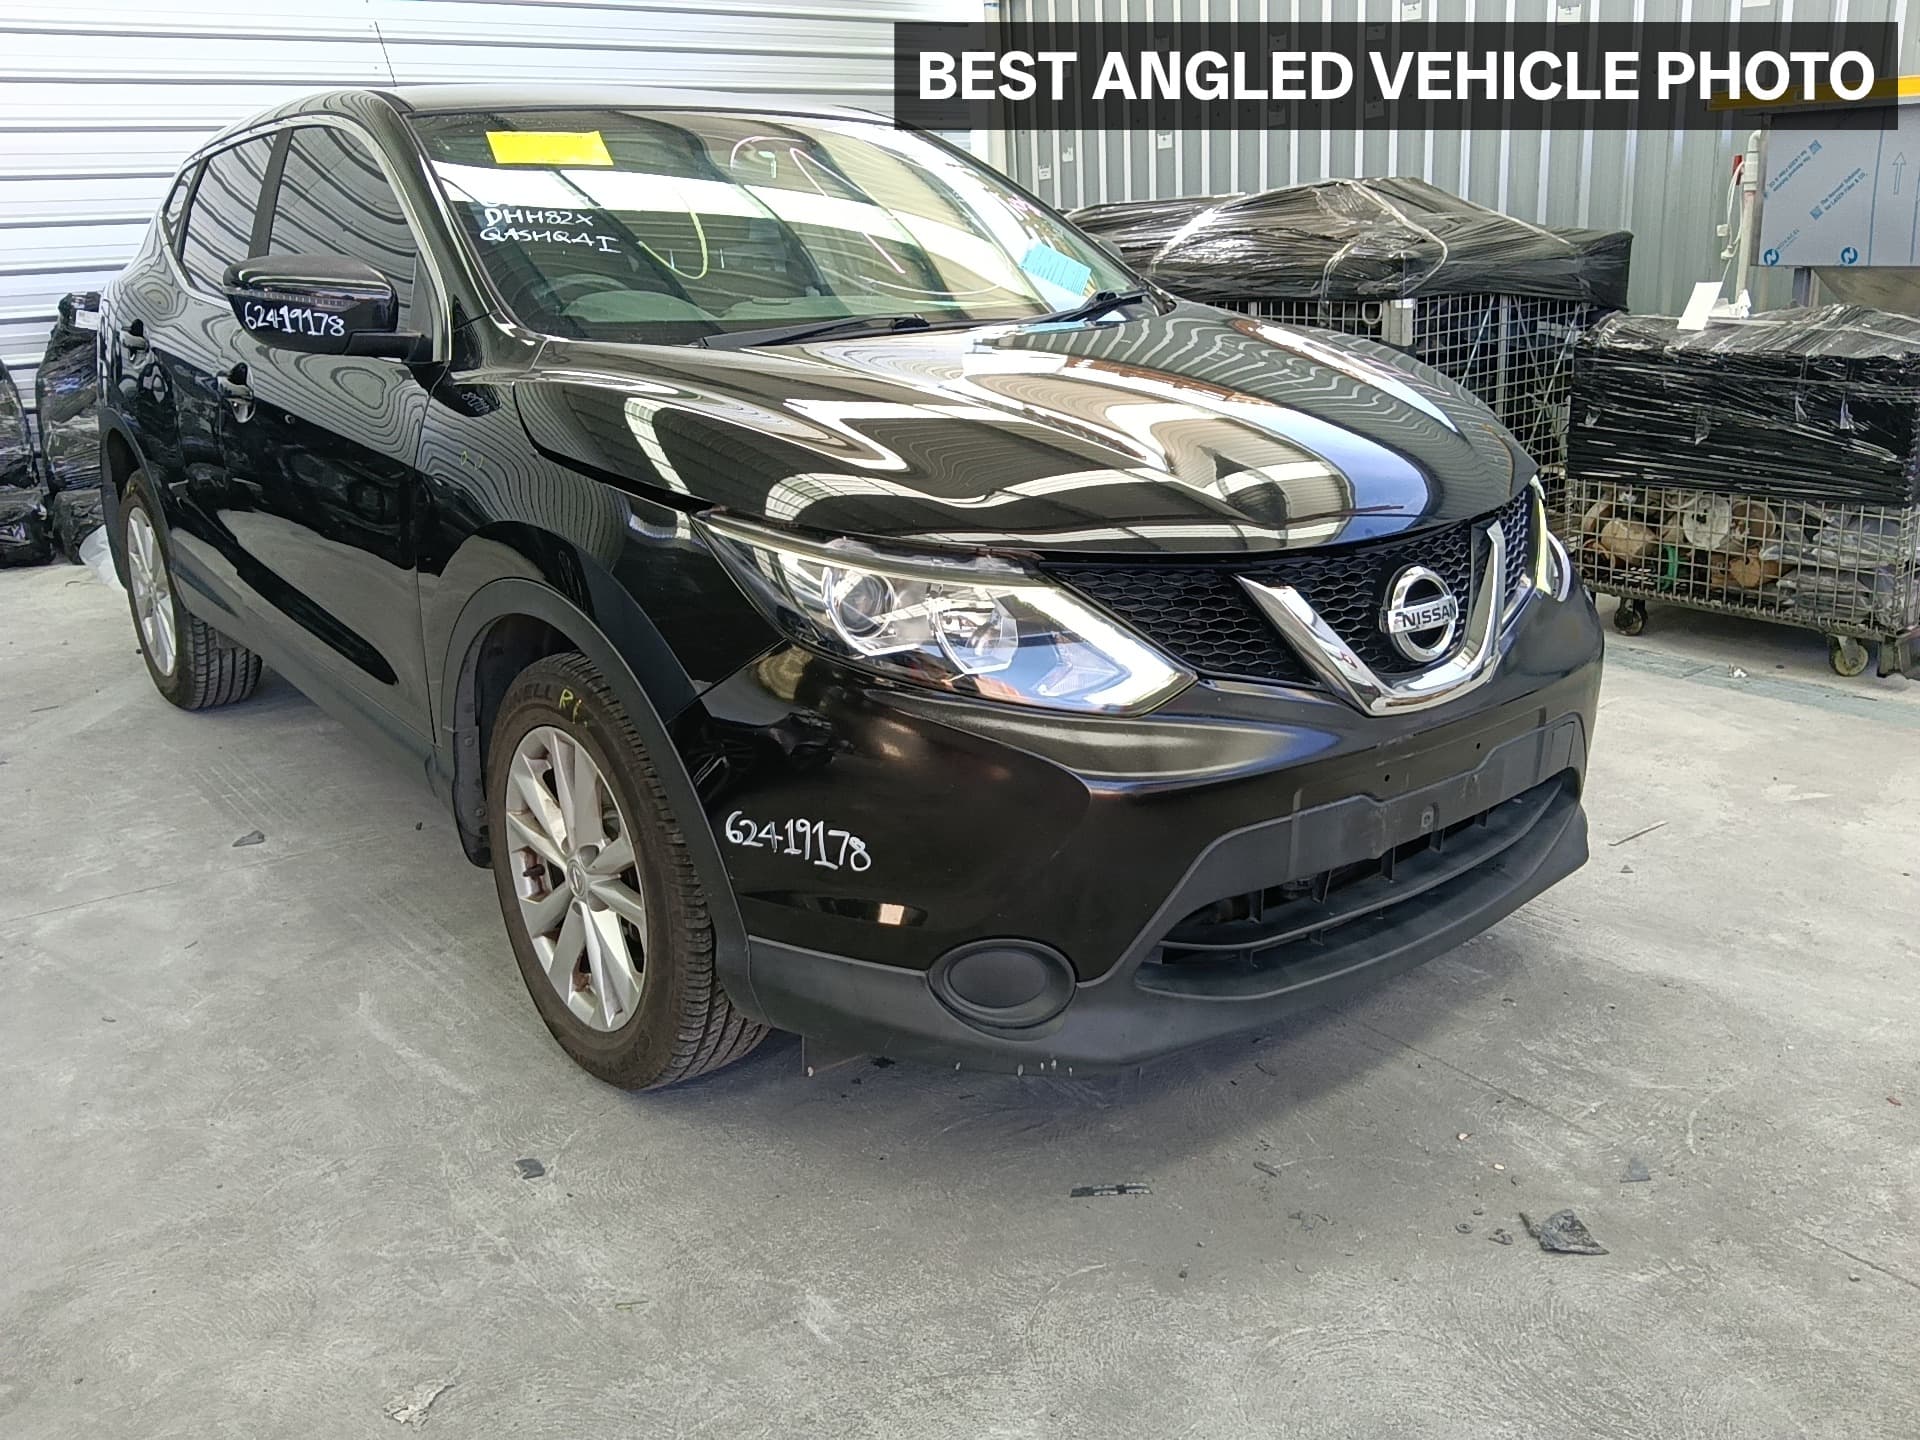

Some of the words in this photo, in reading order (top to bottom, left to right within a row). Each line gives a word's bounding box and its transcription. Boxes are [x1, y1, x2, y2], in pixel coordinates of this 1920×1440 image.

[484, 207, 594, 227] DHH82X
[480, 227, 622, 253] QASHQAI
[244, 302, 345, 337] 62419178
[1402, 602, 1457, 628] NISSAN
[725, 810, 872, 872] 62419178
